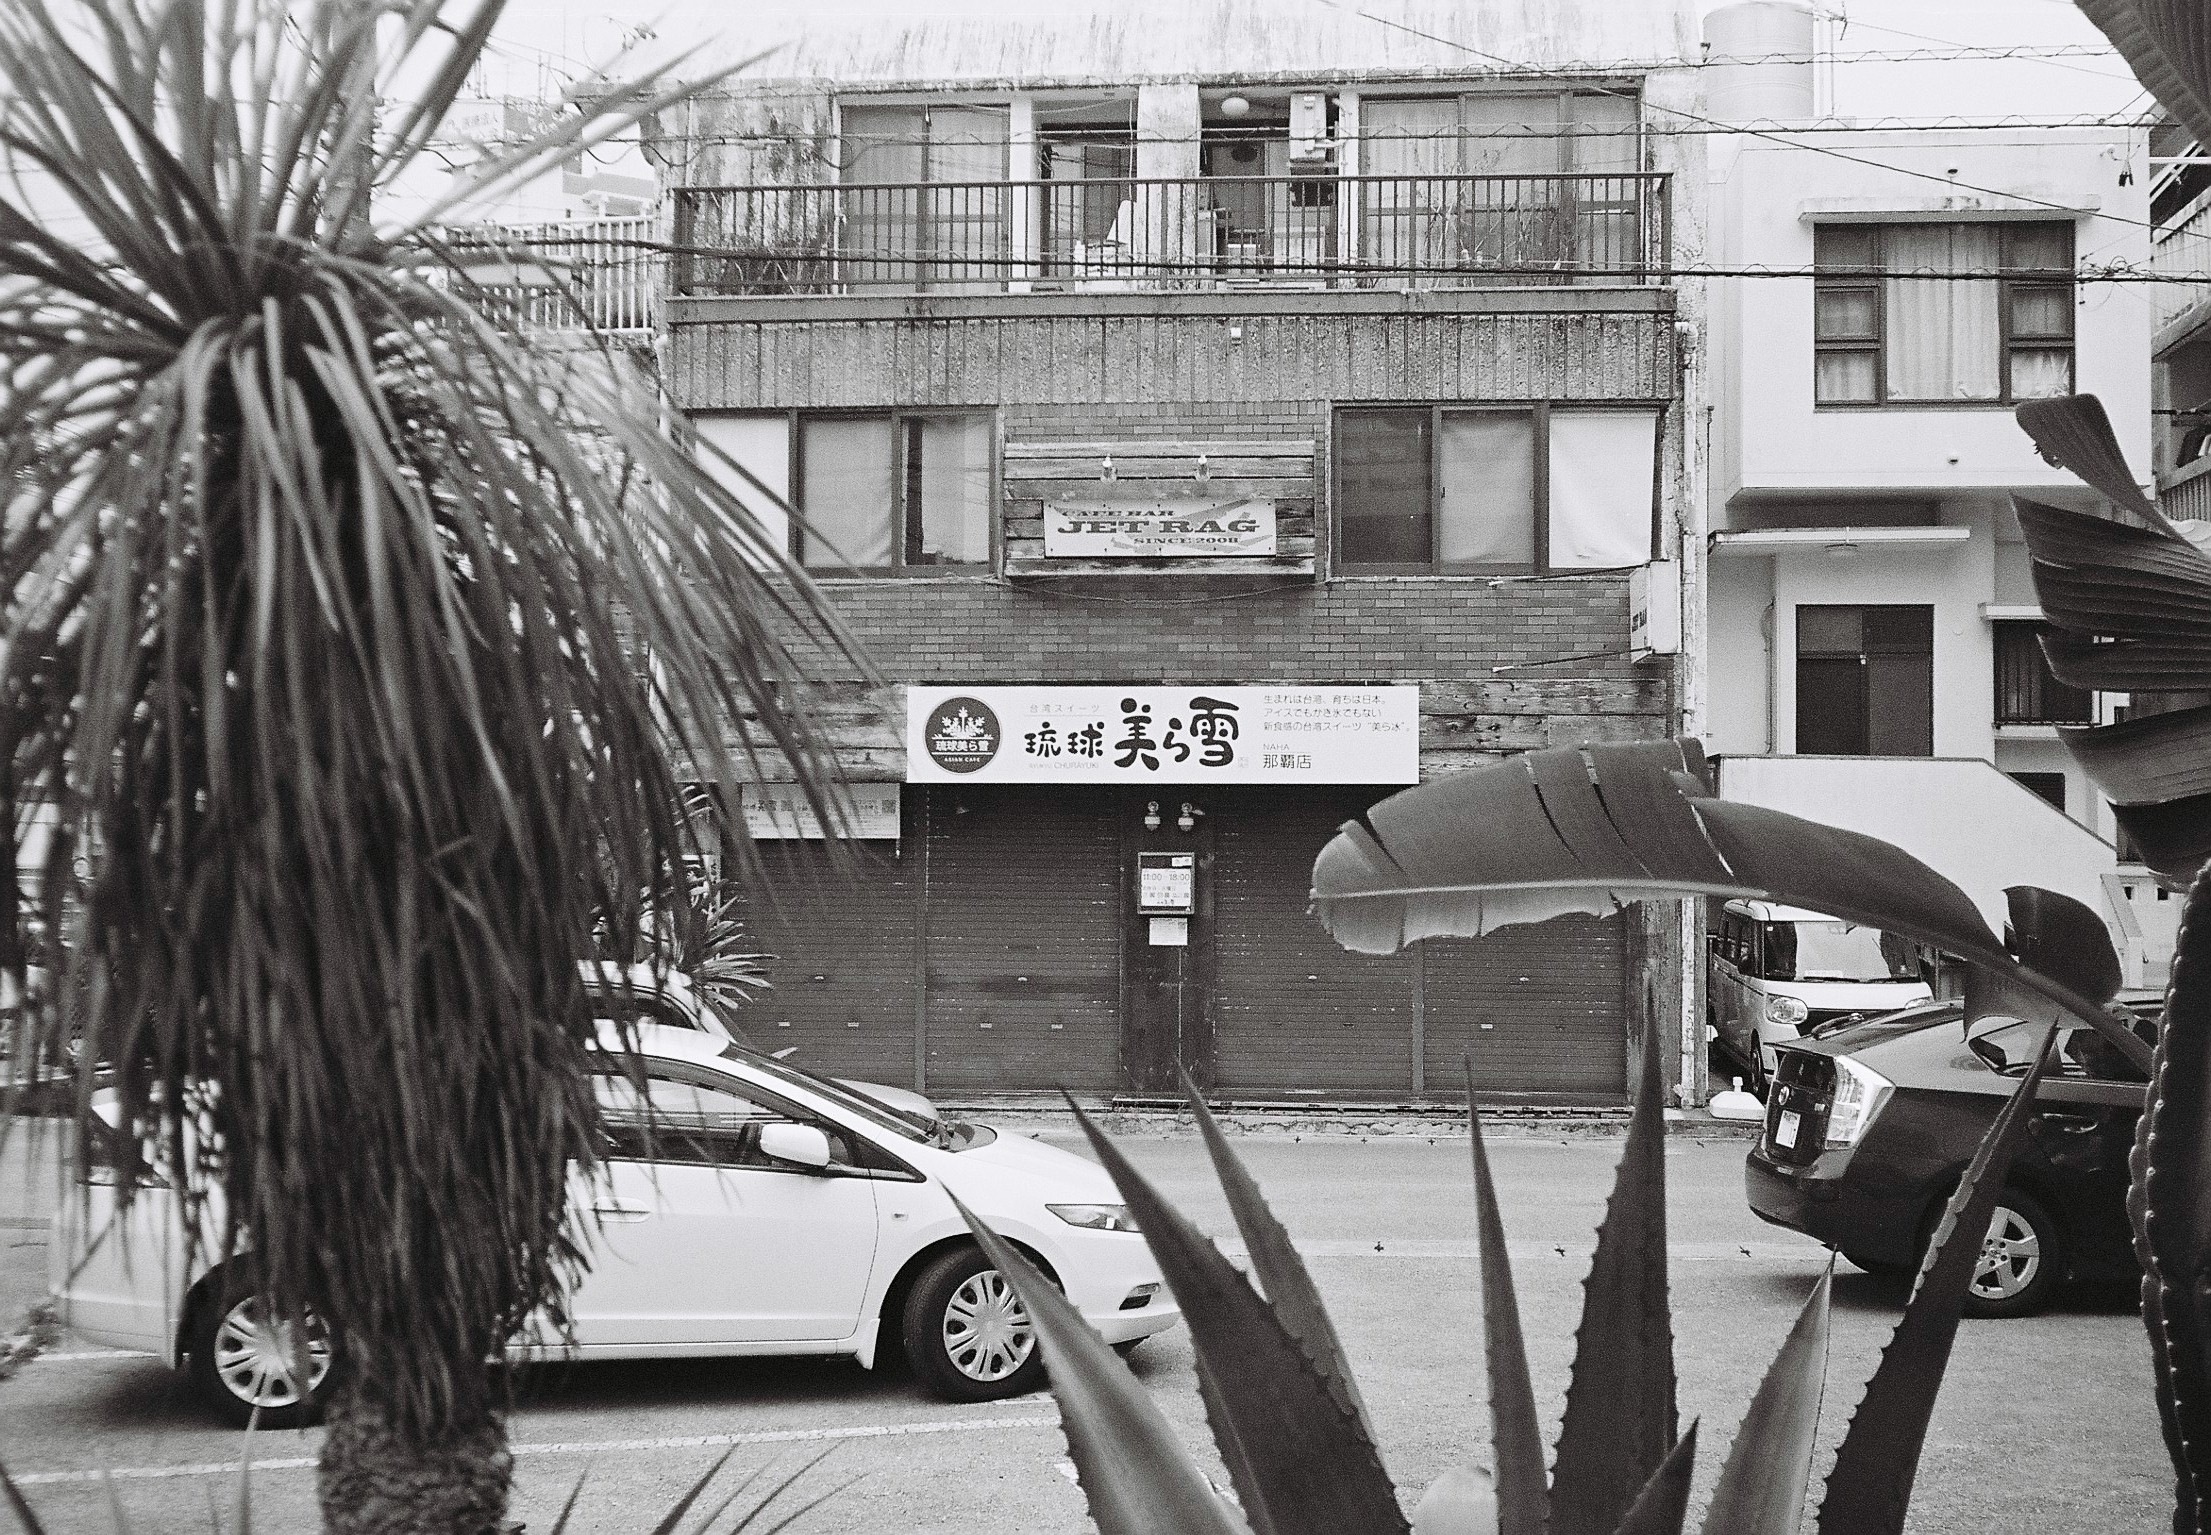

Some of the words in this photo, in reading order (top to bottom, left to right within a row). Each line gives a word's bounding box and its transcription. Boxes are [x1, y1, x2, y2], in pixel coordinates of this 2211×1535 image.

[1057, 520, 1150, 534] JET
[1159, 519, 1260, 533] RAG
[1029, 703, 1100, 714] 台湾スイーツ
[1263, 707, 1382, 718] アイスでもかき氷でもない
[1262, 743, 1290, 751] NAHA
[1262, 753, 1312, 769] 那覇店
[1143, 873, 1163, 881] 11:00
